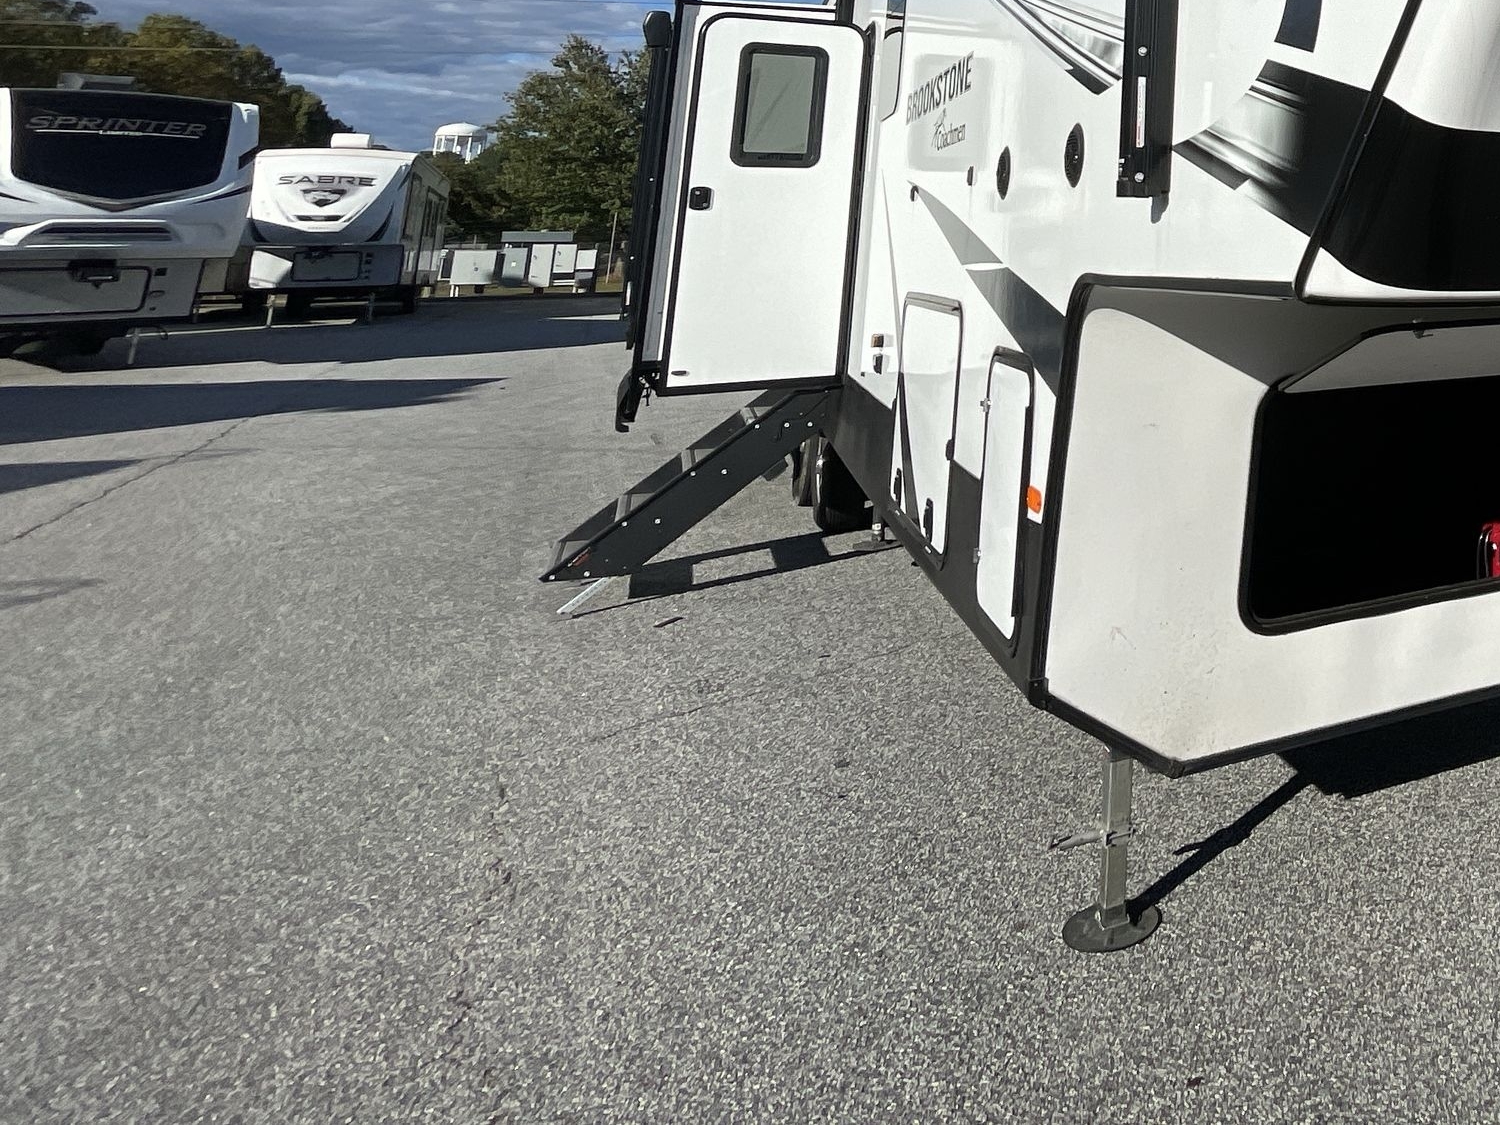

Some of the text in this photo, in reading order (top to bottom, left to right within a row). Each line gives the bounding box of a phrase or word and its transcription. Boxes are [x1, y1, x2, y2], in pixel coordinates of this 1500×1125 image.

[905, 51, 975, 126] BROOKSTONE
[25, 115, 207, 137] SPRINTER
[936, 123, 966, 151] Coachmen
[276, 175, 378, 187] SABRE
